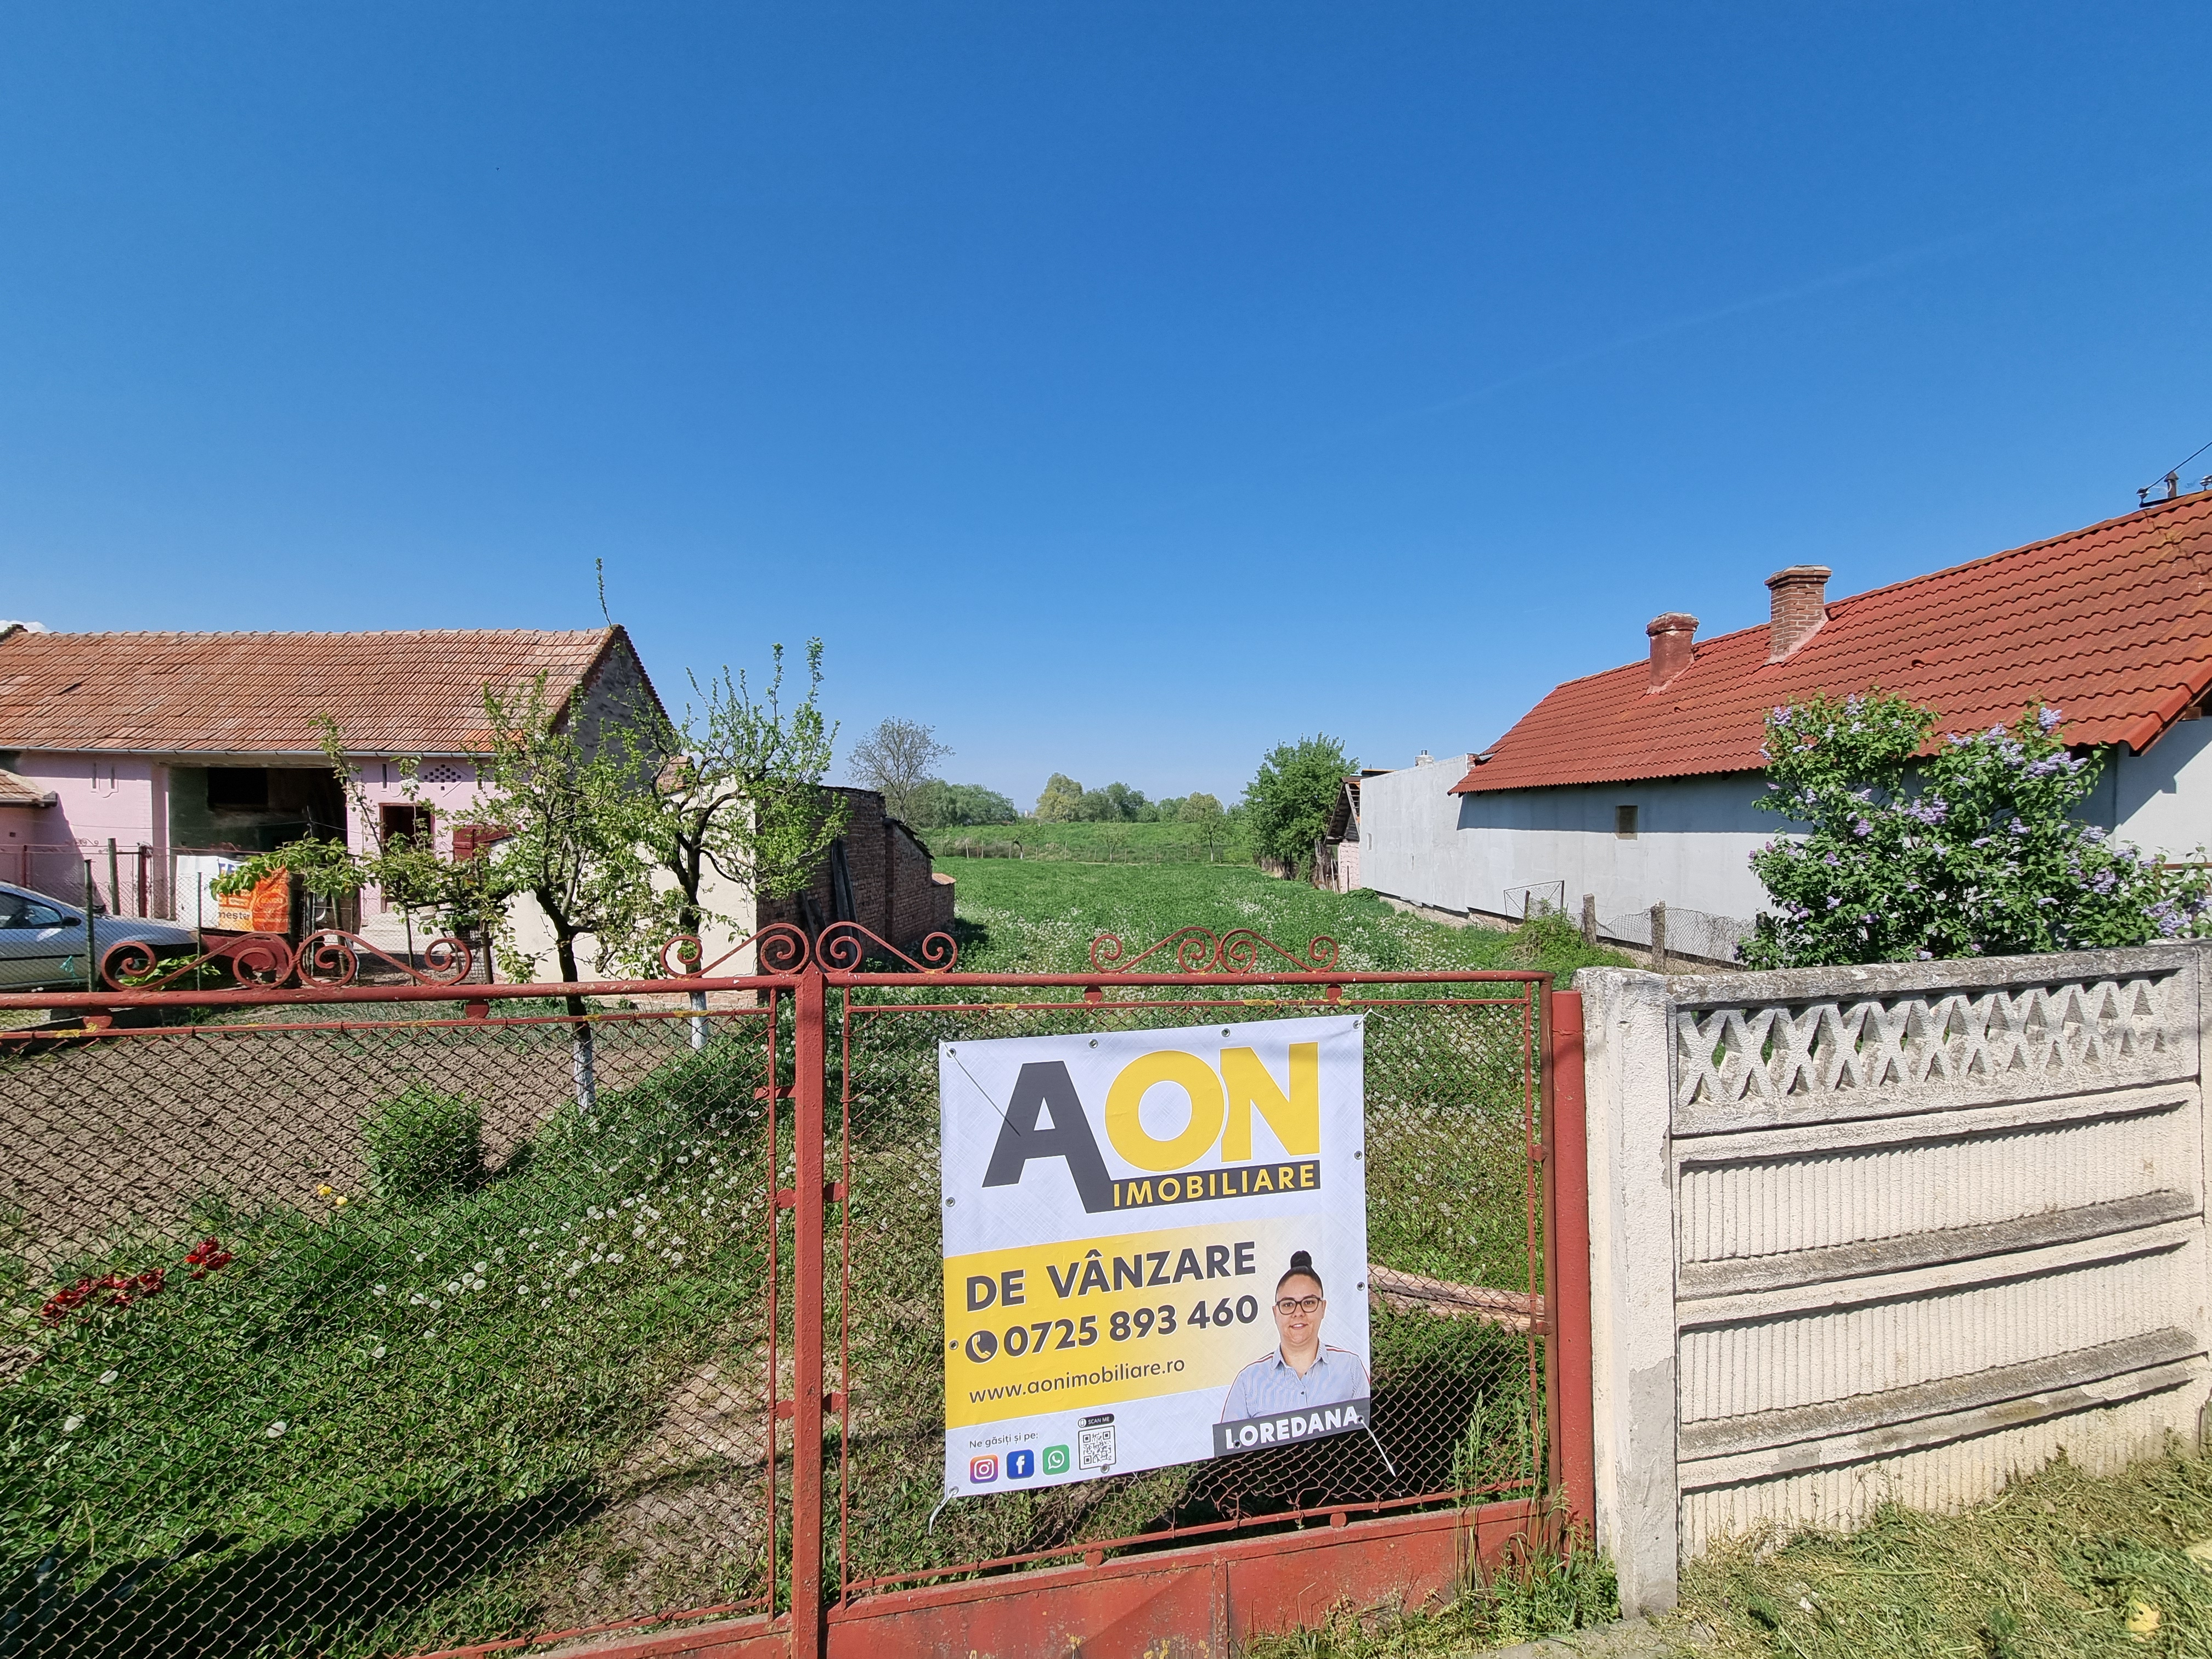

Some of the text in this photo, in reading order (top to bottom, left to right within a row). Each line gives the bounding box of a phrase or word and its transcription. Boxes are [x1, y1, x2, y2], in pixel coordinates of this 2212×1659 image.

[982, 1042, 1320, 1214] AON
[1114, 1164, 1316, 1207] IMOBILIARE
[966, 1242, 1256, 1312] DE VÂNZARE
[1003, 1294, 1258, 1357] 0725 893 460
[969, 1359, 1185, 1404] www.aonimobiliare.ro
[969, 1440, 982, 1448] Ne
[1024, 1432, 1039, 1441] pe:
[1225, 1406, 1358, 1450] LOREDANA
